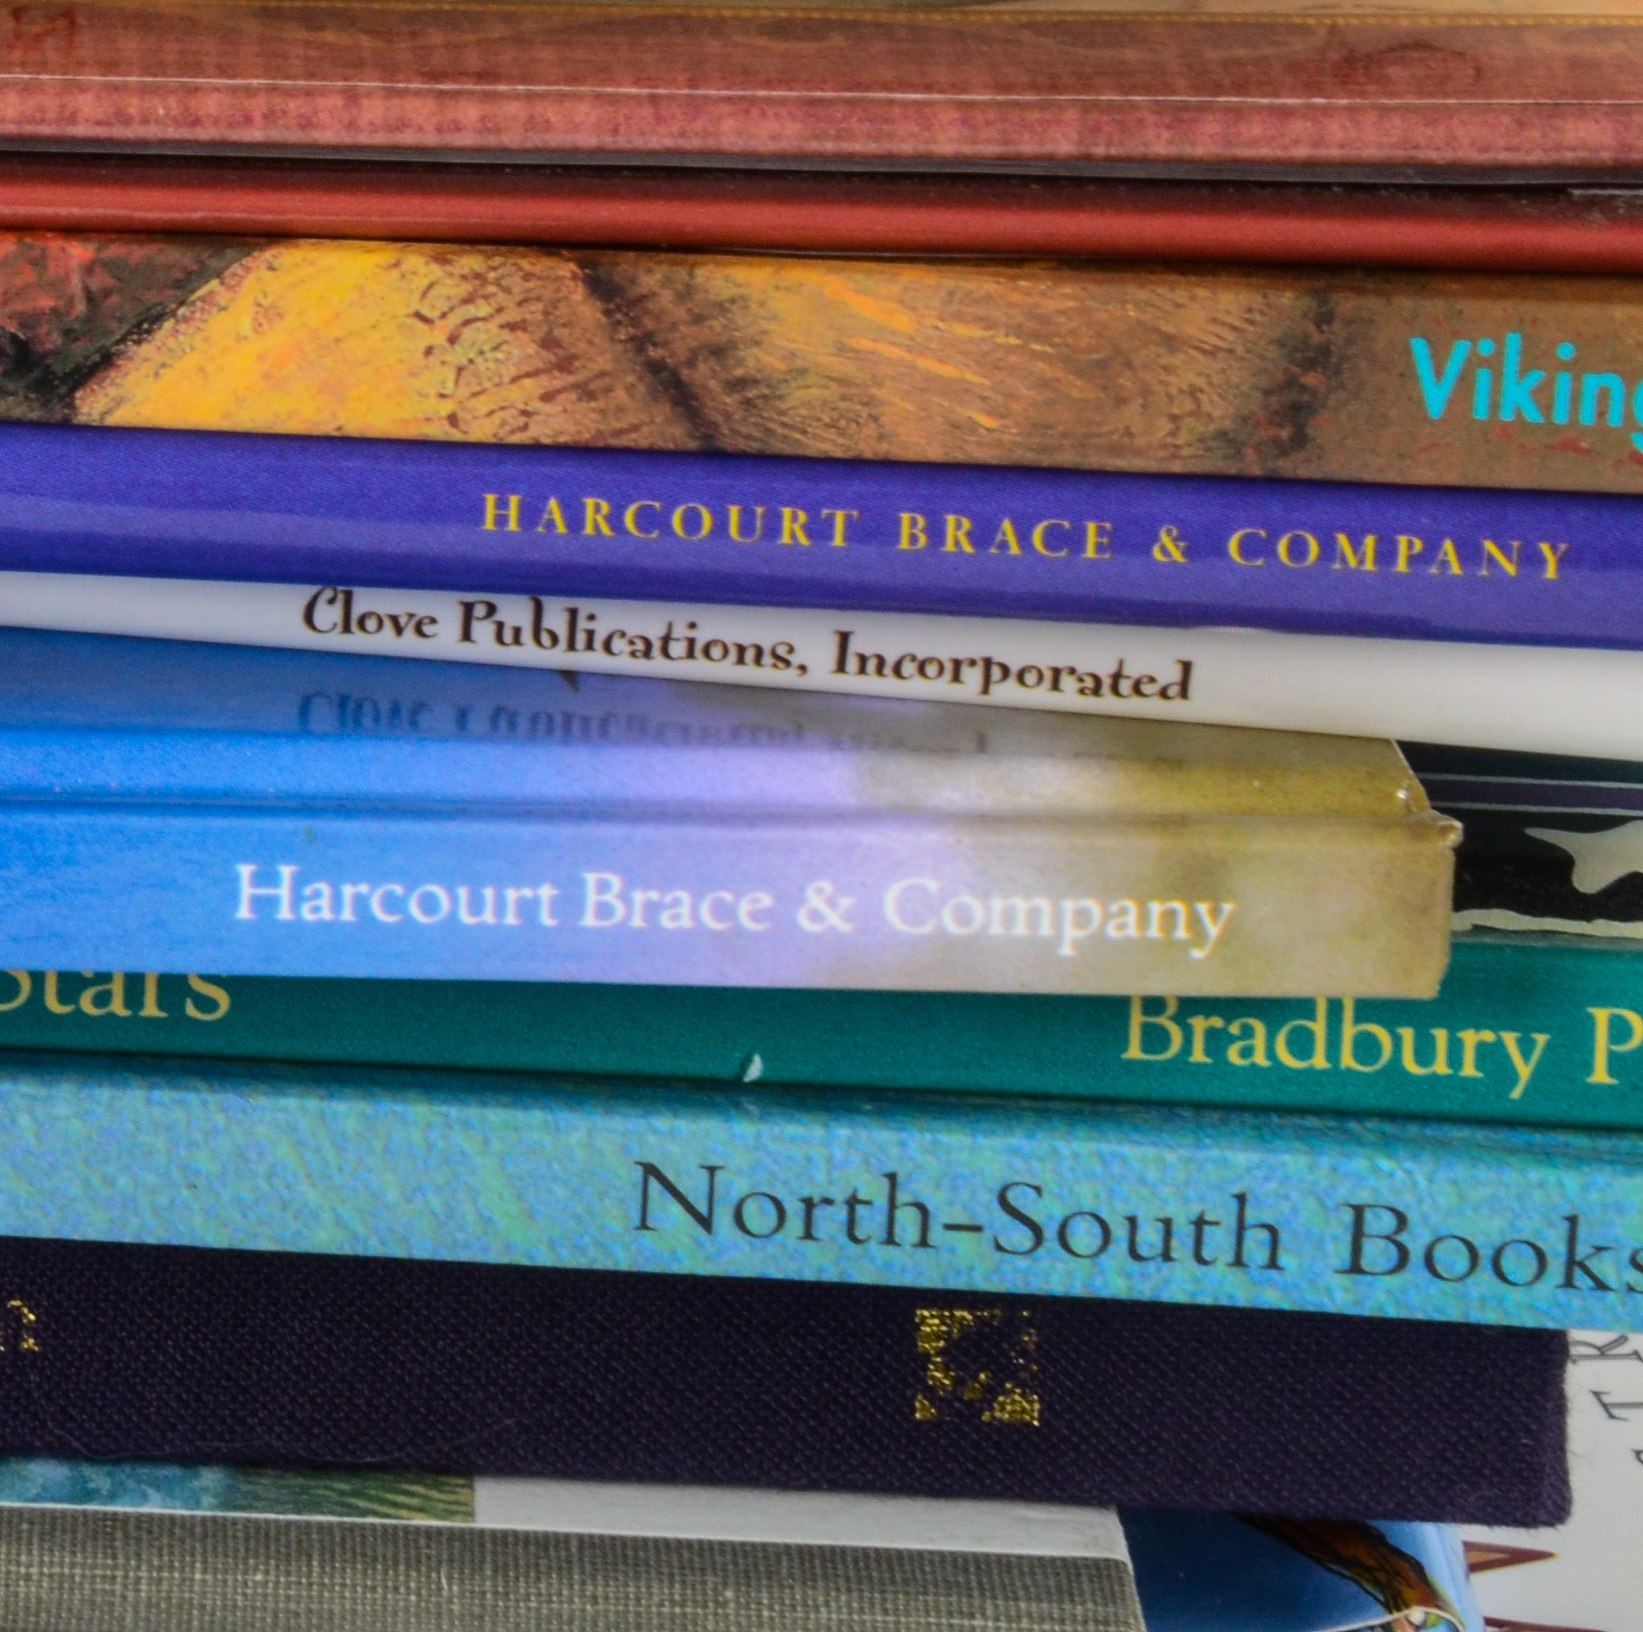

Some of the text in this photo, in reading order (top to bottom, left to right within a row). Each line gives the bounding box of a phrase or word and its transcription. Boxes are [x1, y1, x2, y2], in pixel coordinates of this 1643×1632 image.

[480, 491, 1572, 582] HARCOURT BRACE & COMPANY
[302, 585, 1194, 704] Clove Publications, Incorporated
[234, 862, 1236, 961] Harcourt Brace & Company
[1123, 992, 1552, 1100] Bradbury
[633, 1160, 1284, 1272] North-South
